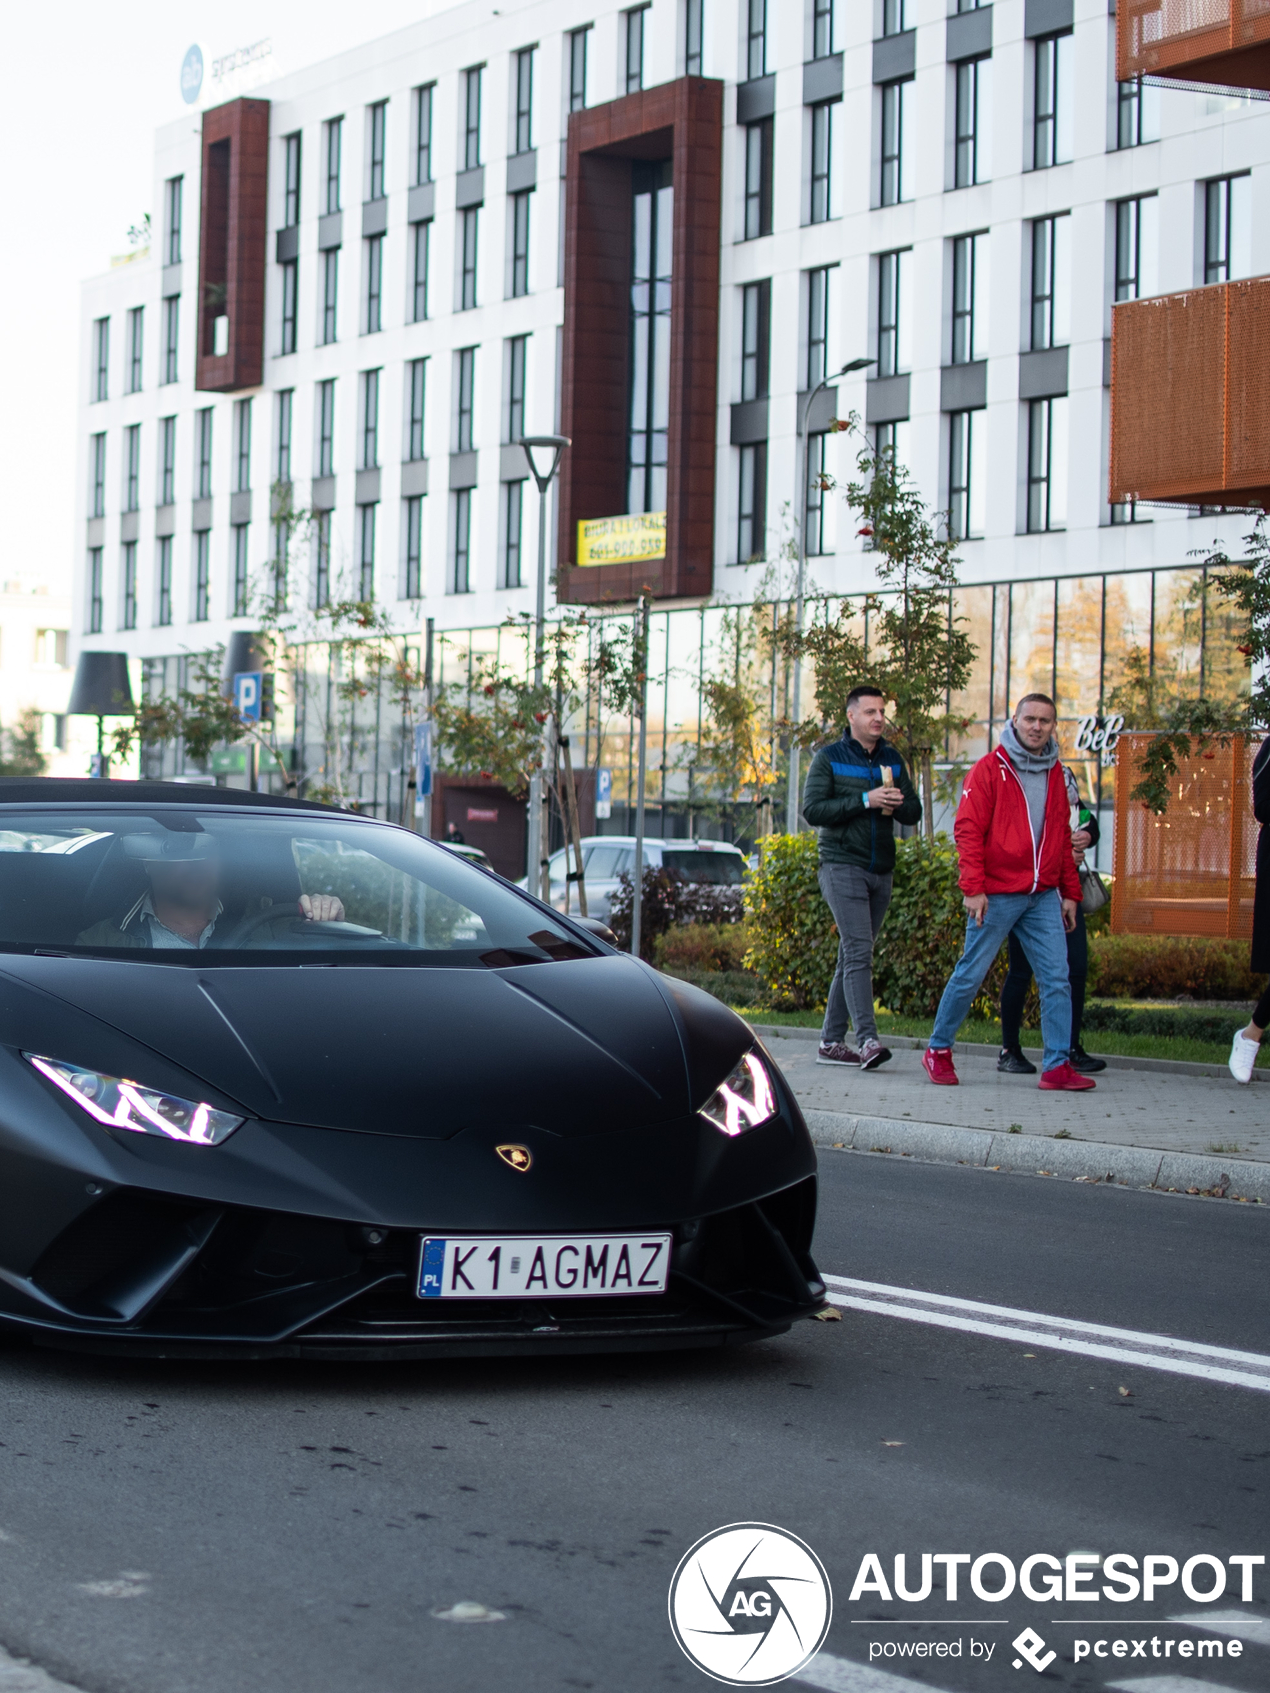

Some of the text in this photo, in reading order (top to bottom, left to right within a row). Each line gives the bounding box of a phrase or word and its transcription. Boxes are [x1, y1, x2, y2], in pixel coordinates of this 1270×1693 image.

[240, 678, 256, 717] P
[600, 771, 609, 793] P
[423, 1274, 440, 1287] PL
[451, 1242, 663, 1291] K1 AGMAZ
